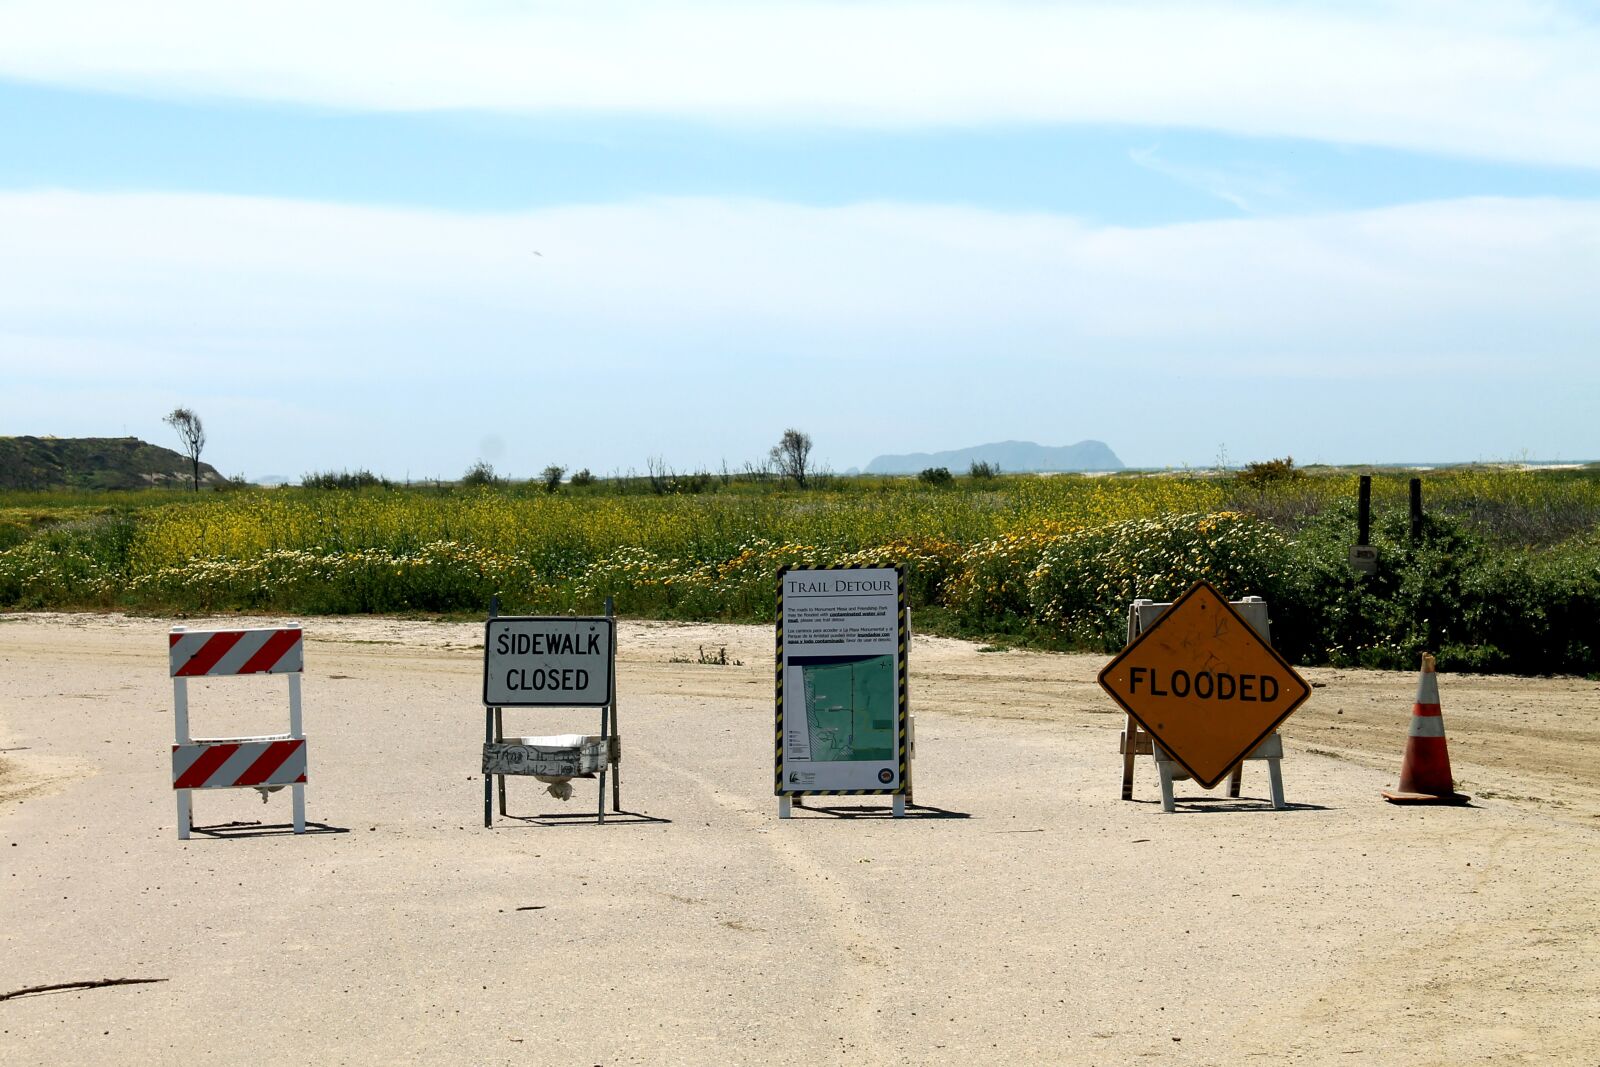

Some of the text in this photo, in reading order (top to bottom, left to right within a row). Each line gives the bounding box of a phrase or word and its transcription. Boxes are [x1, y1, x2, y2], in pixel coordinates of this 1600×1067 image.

[497, 633, 600, 655] SIDEWALK
[506, 669, 589, 690] CLOSED
[1130, 667, 1279, 702] FLOODED
